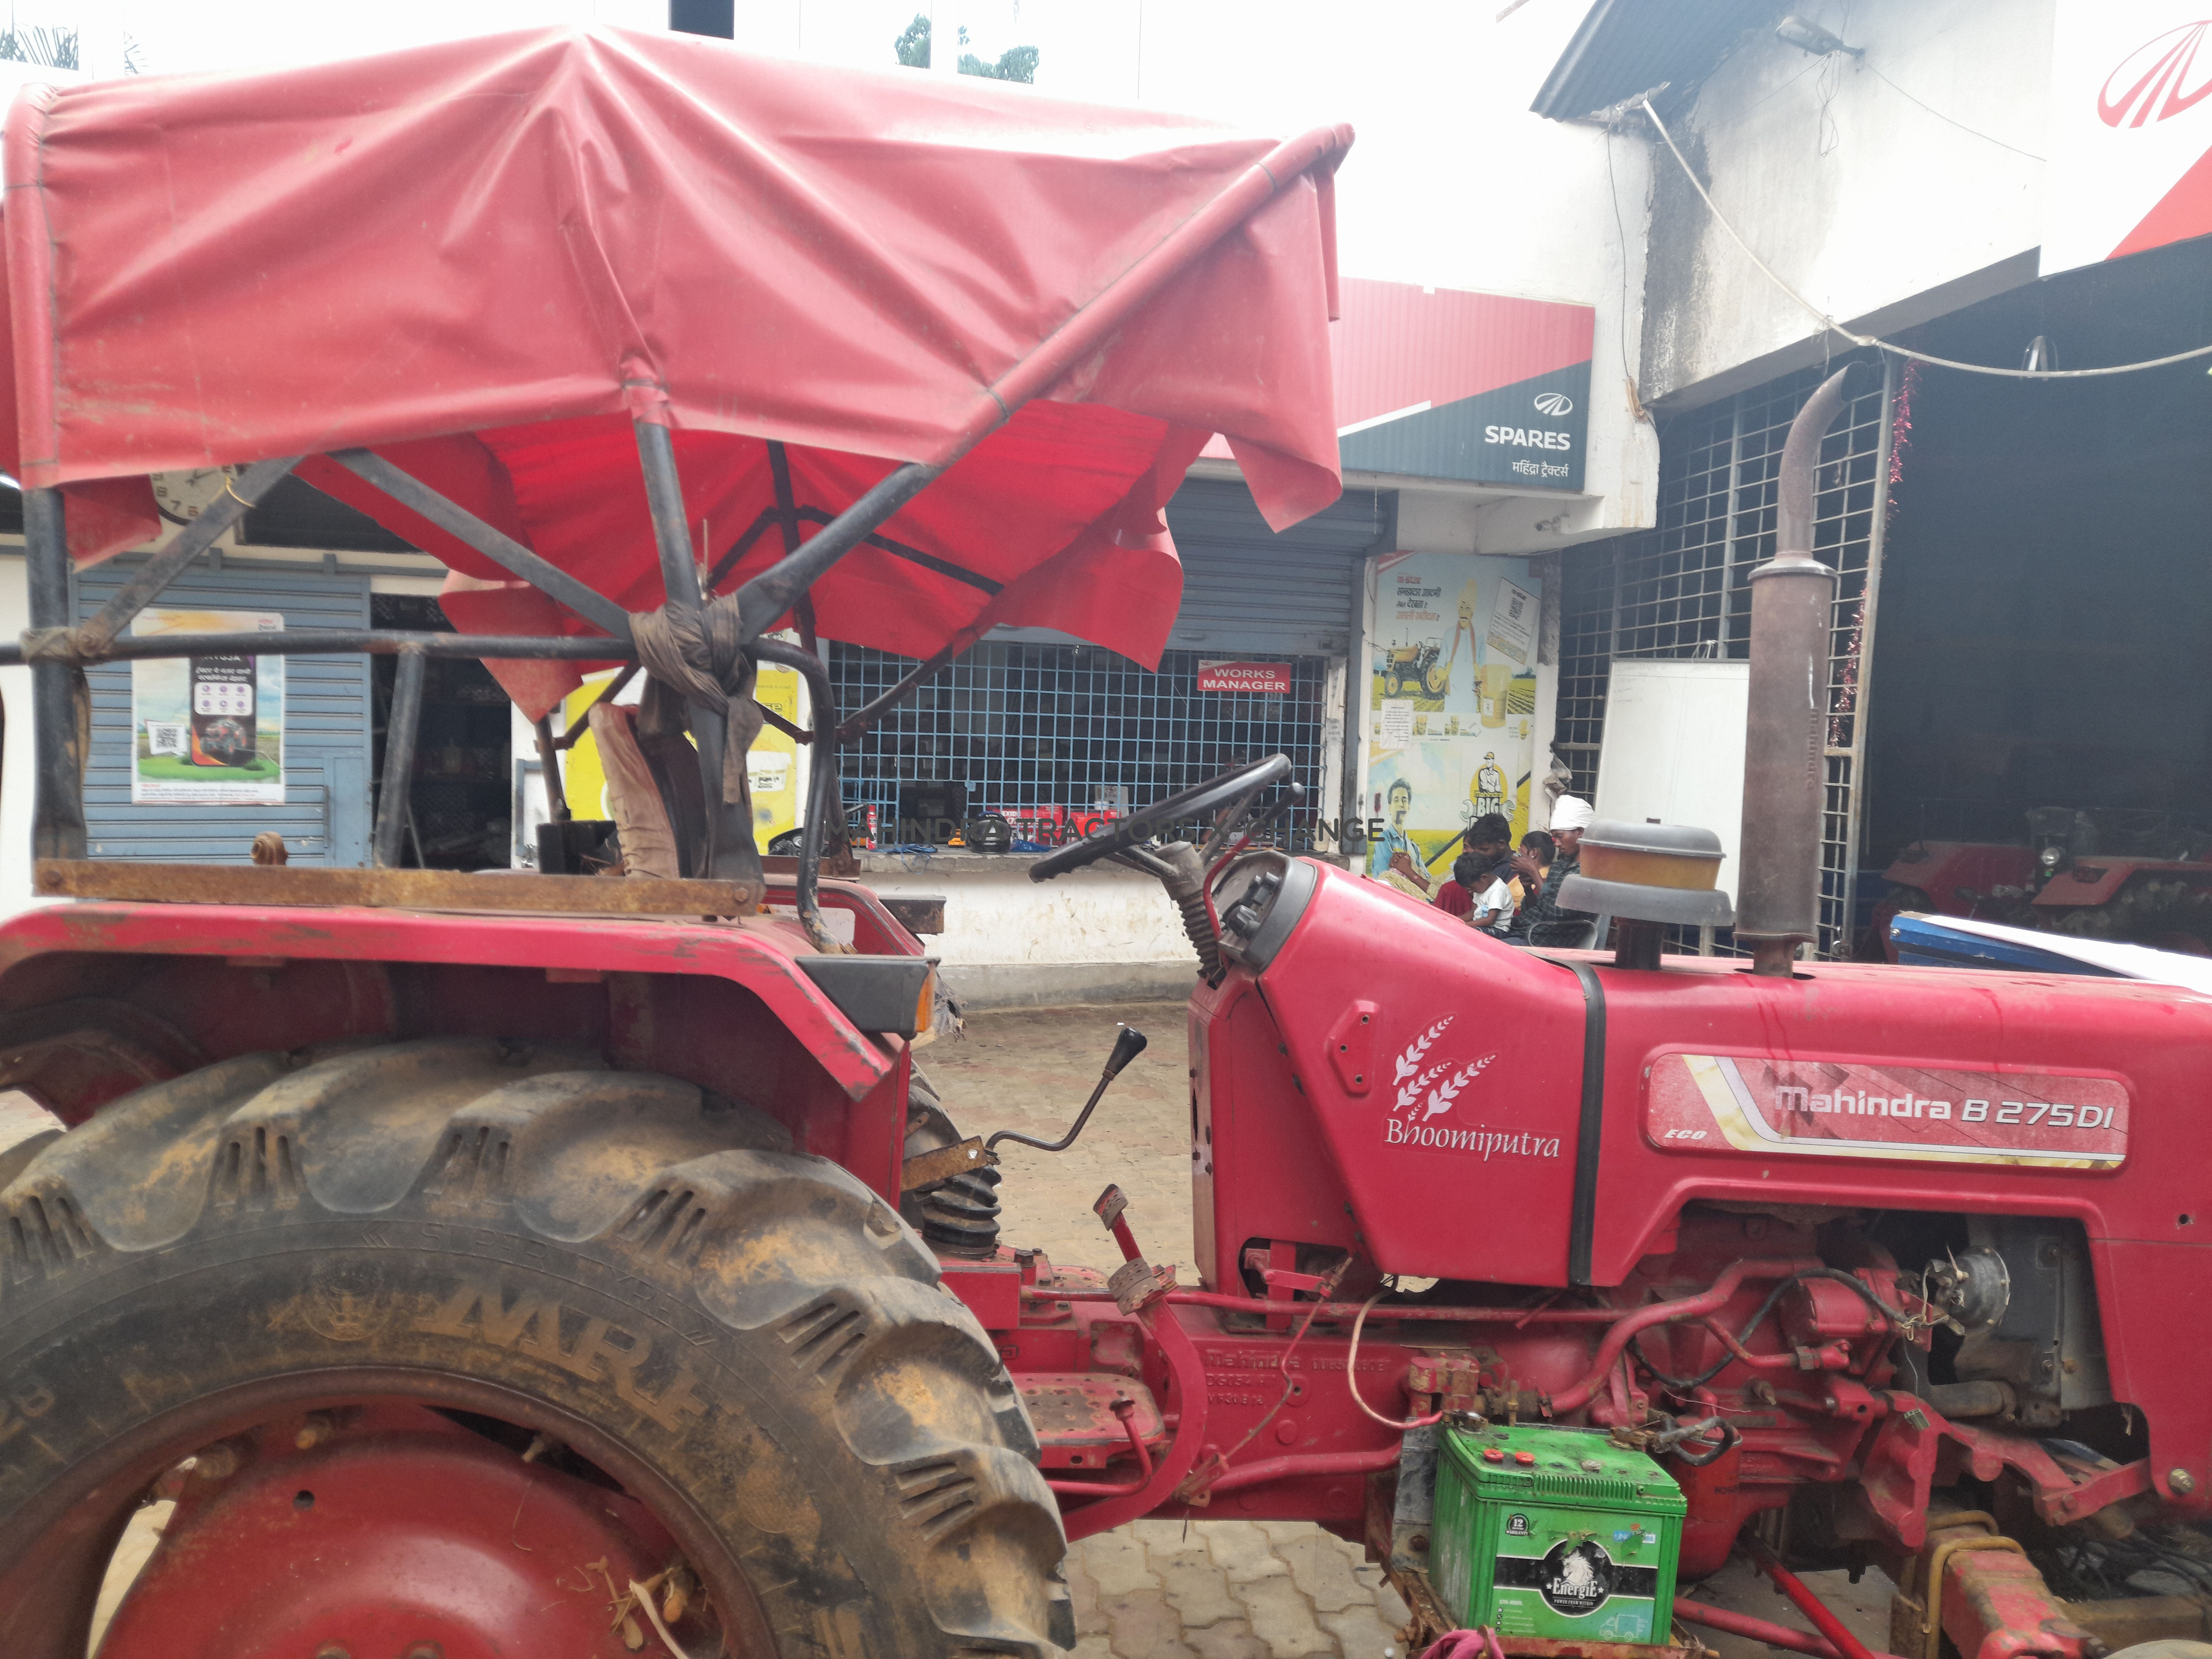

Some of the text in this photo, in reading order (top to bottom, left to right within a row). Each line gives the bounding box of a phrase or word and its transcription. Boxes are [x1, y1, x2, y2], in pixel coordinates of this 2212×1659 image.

[1484, 425, 1571, 450] SPARES
[1512, 460, 1569, 477] महिंद्रा ट्रैक्टर्स
[1214, 668, 1276, 679] WORKS
[1202, 679, 1286, 691] MANAGER
[1477, 797, 1501, 817] BIG
[1385, 1118, 1560, 1162] Bhoomiputra
[1663, 1129, 1707, 1140] ECO
[1513, 1518, 1524, 1527] 12
